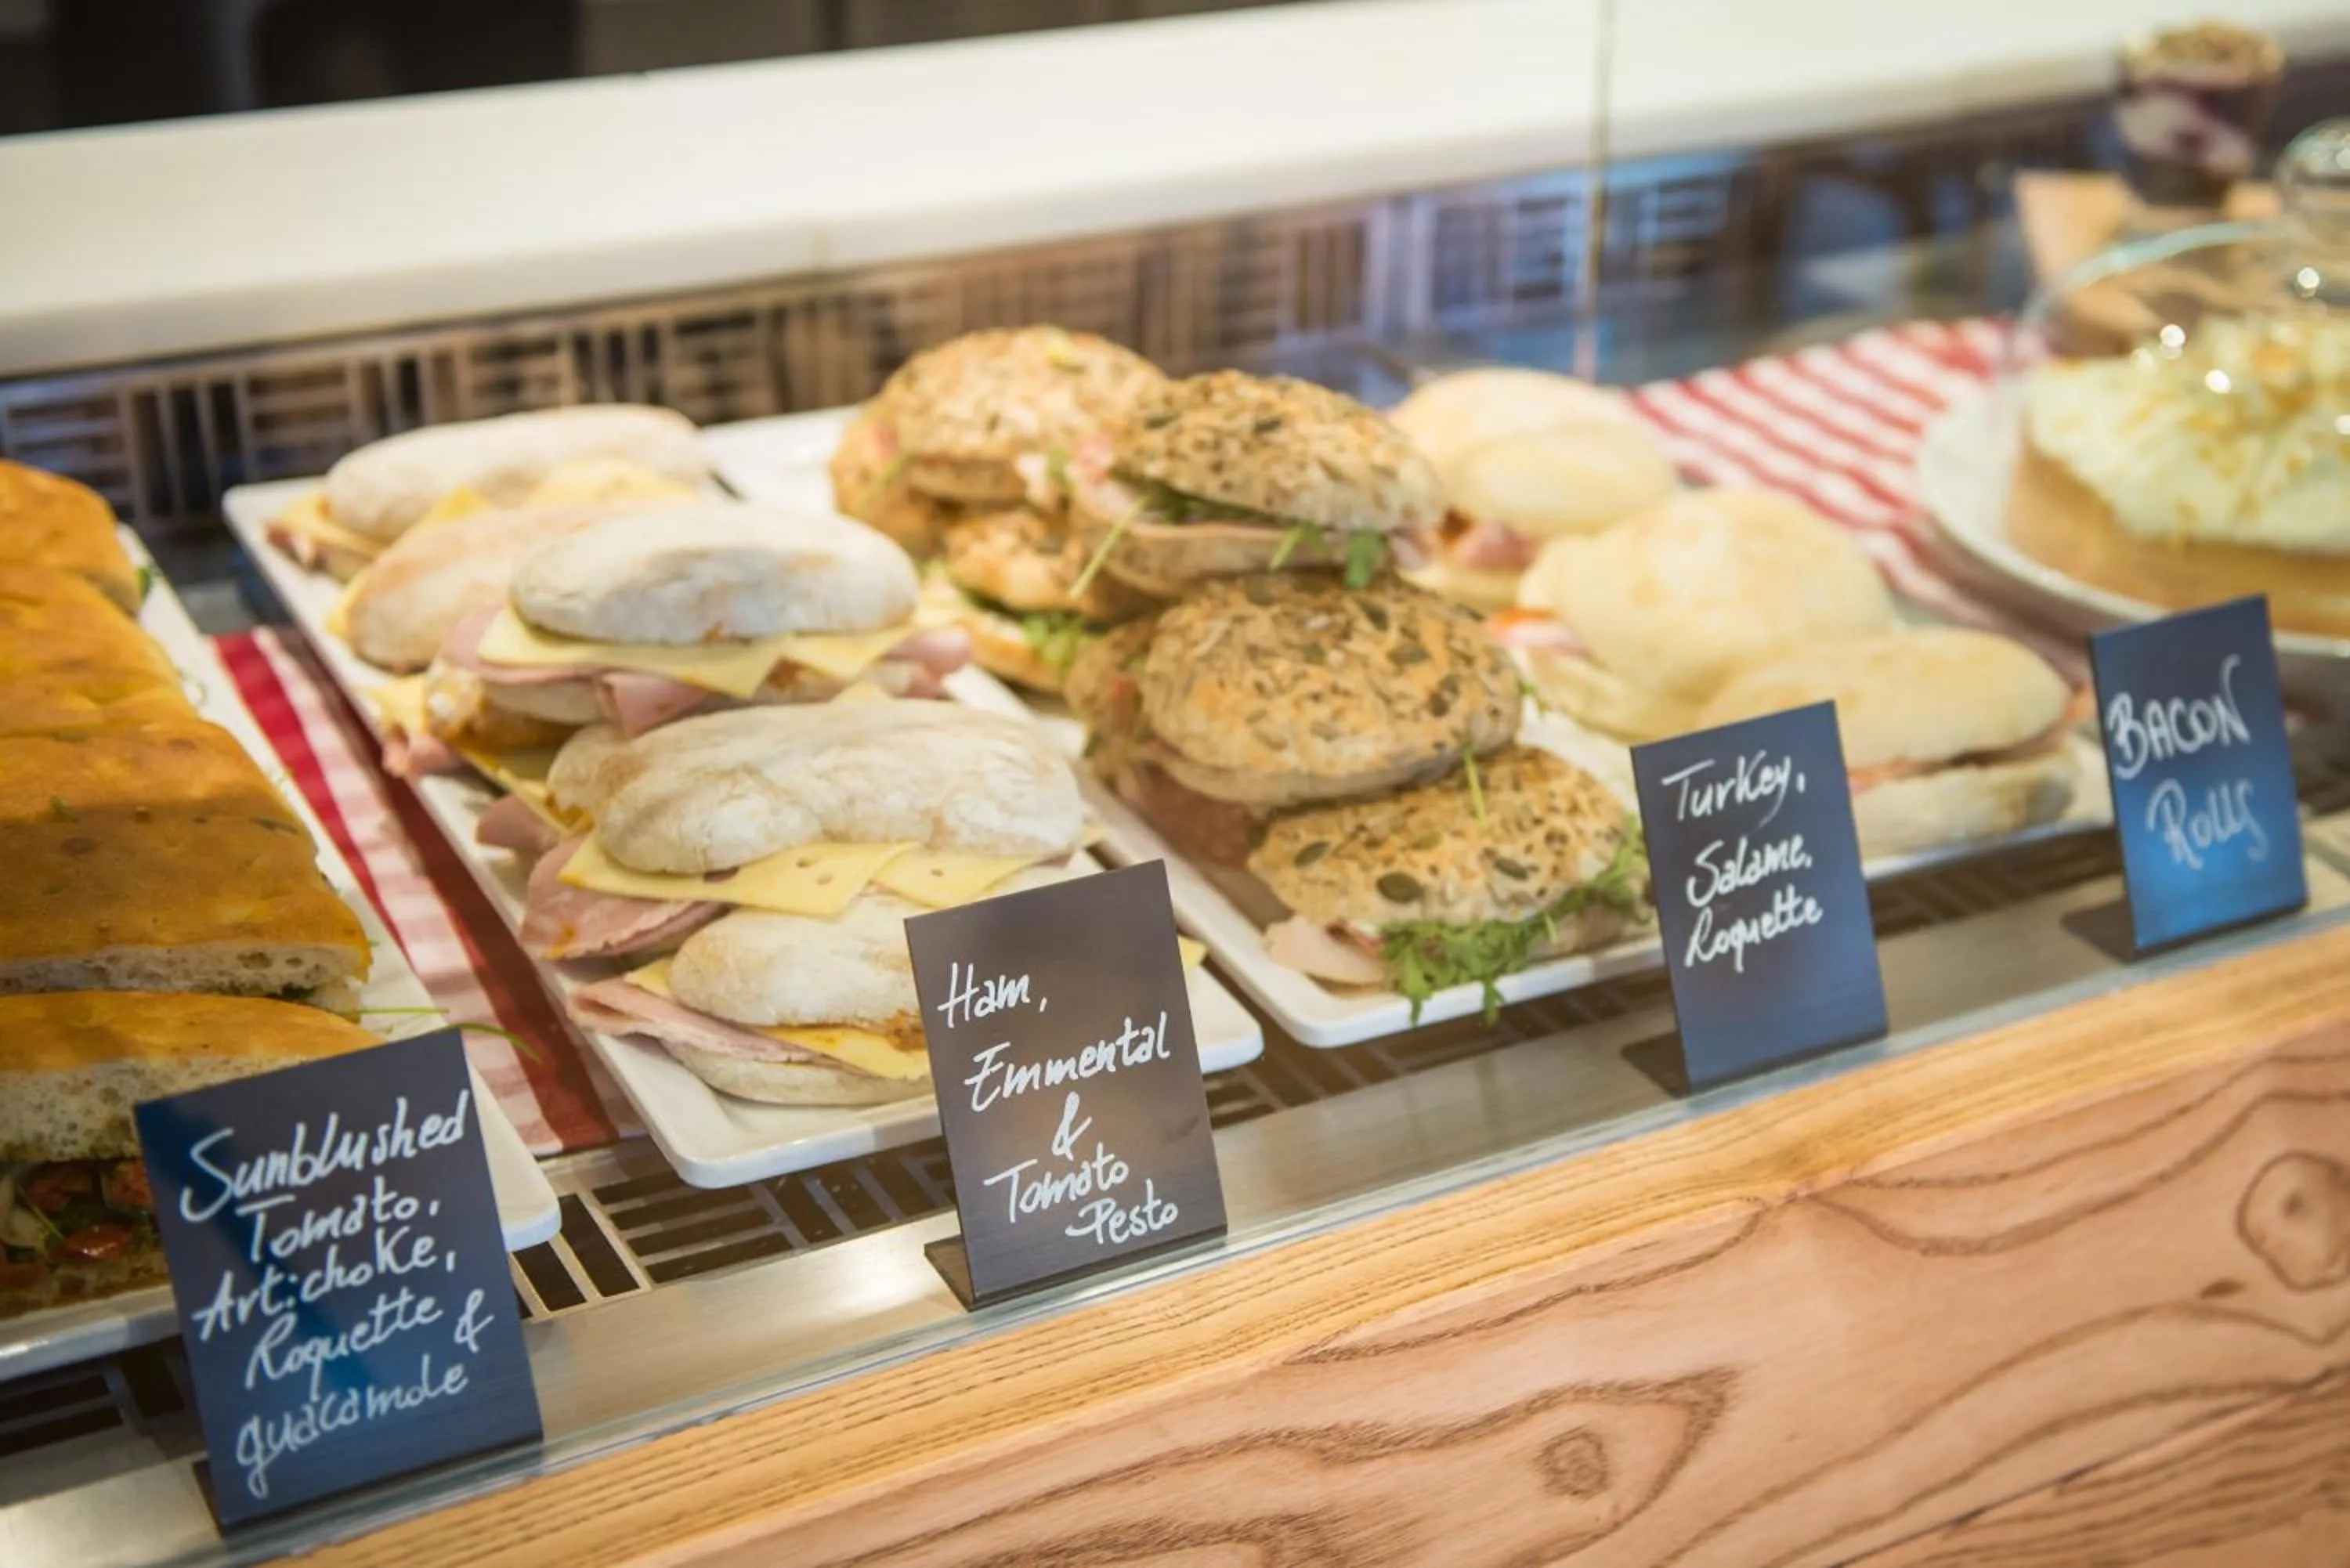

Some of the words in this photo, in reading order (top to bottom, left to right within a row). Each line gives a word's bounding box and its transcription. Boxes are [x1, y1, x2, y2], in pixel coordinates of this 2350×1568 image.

[2106, 653, 2251, 780] BACON
[1684, 884, 1823, 972] Roquette
[938, 963, 1047, 1028] Ham,
[964, 1011, 1170, 1112] Emmental
[180, 1089, 470, 1223] Sunblushed
[1052, 1092, 1092, 1161] &
[984, 1142, 1129, 1223] Tomato
[1065, 1179, 1178, 1245] Pesto
[244, 1287, 443, 1402] Roquette
[454, 1288, 494, 1353] &
[235, 1354, 469, 1499] guacamole
